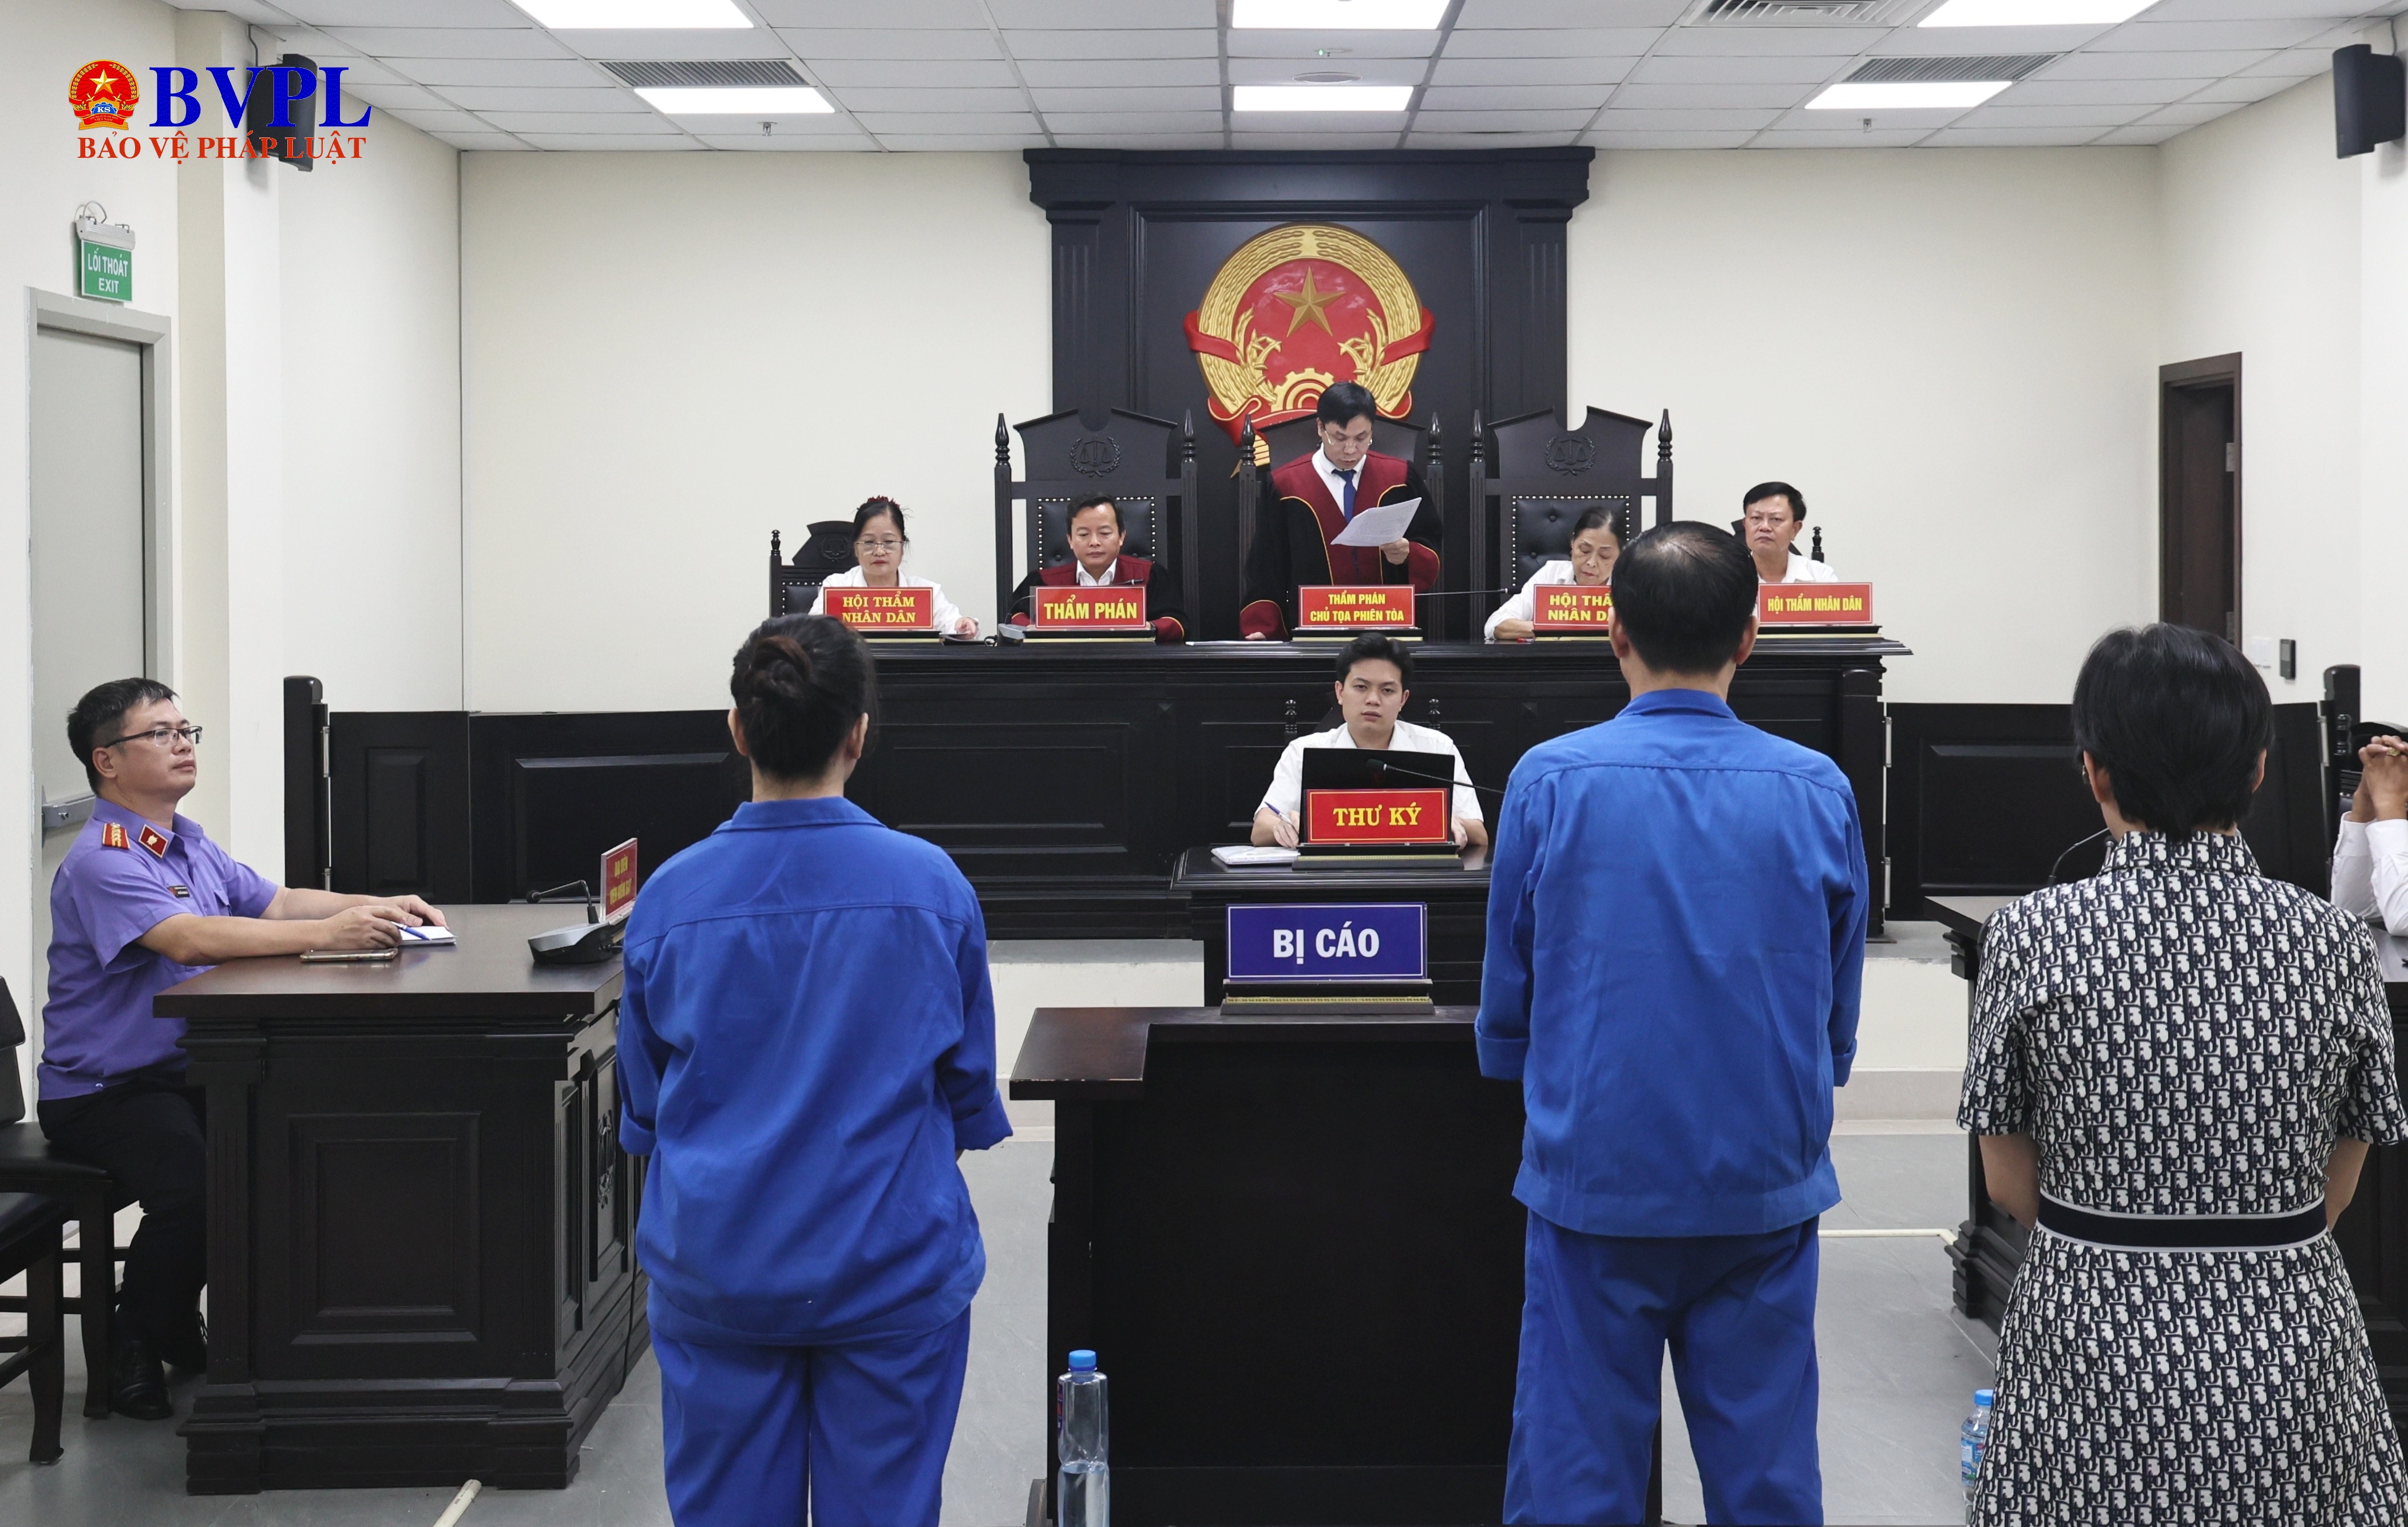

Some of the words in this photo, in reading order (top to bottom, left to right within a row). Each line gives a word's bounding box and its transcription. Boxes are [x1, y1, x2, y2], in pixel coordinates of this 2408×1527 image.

[88, 247, 101, 272] LỐI
[102, 253, 128, 277] THOÁT
[98, 277, 119, 293] EXIT
[842, 594, 869, 609] HỘI
[873, 591, 915, 607] THẨM
[1328, 590, 1356, 604] THẨM
[1359, 592, 1385, 604] PHÁN
[1550, 592, 1577, 608] HỘI
[1768, 596, 1783, 614] HỘI
[1786, 593, 1812, 611] THẨM
[1814, 595, 1840, 611] NHÂN
[1843, 595, 1862, 610] DÂN
[842, 609, 881, 622] NHÂN
[886, 609, 916, 622] DÂN
[1043, 594, 1089, 619] THẨM
[1095, 598, 1137, 619] PHÁN
[1310, 606, 1330, 621] CHỦ
[1332, 610, 1351, 624] TỌA
[1353, 609, 1383, 621] PHIÊN
[1385, 608, 1404, 621] TÒA
[1548, 608, 1591, 621] NHÂN
[1333, 804, 1383, 826] THƯ
[1388, 802, 1422, 826] KÝ
[1273, 929, 1304, 965] BỊ
[1316, 921, 1380, 958] CÁO
